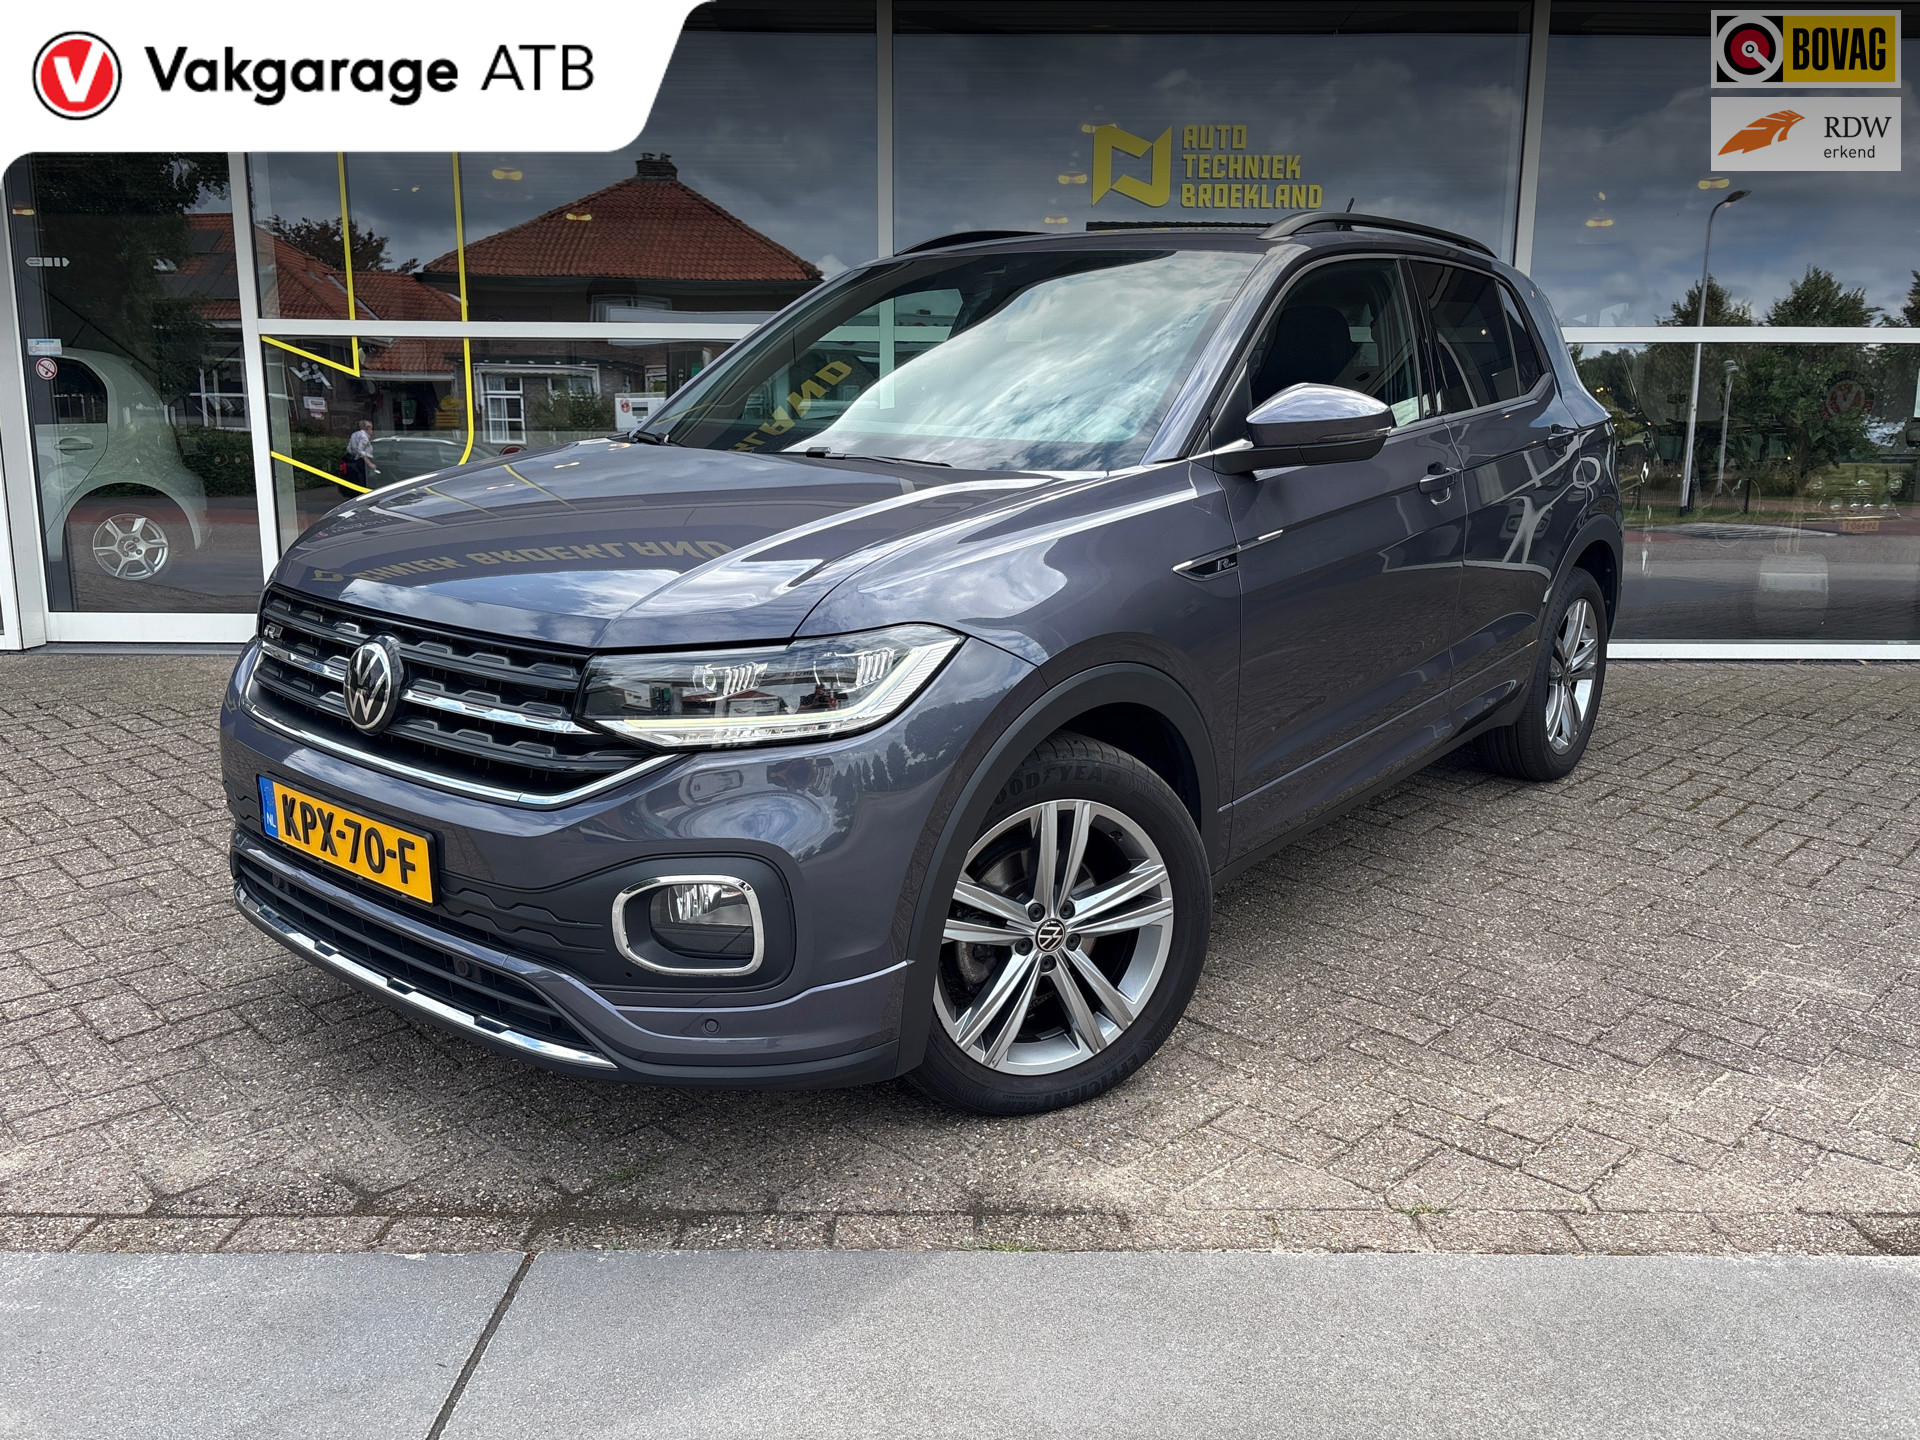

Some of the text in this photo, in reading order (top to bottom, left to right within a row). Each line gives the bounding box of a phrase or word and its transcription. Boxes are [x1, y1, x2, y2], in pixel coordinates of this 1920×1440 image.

[1183, 124, 1248, 149] AUTO
[1182, 154, 1302, 179] TECHNIEK
[1181, 183, 1324, 209] BROEKLAND
[265, 793, 417, 885] NL KPX-70-F
